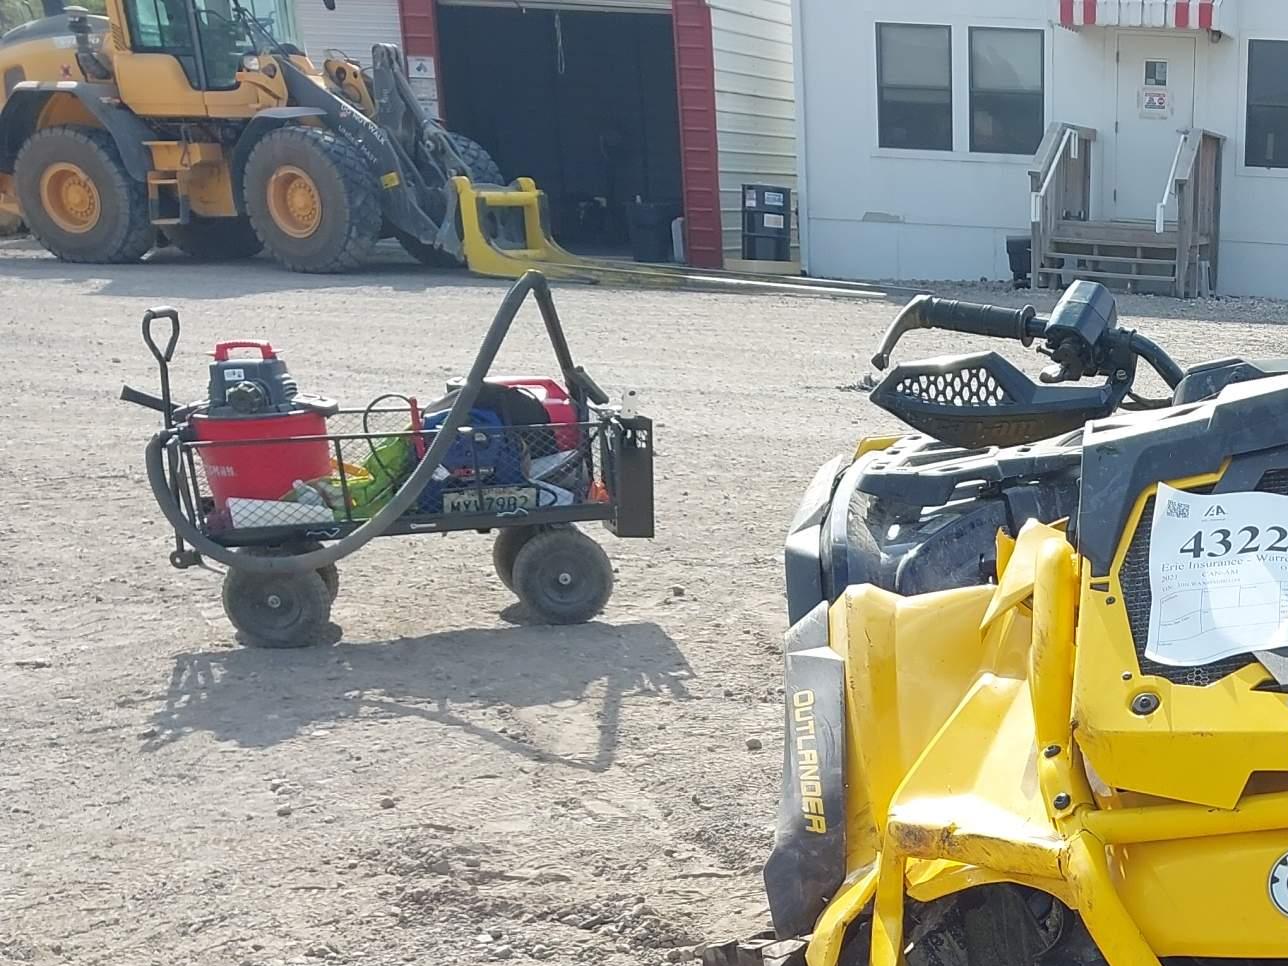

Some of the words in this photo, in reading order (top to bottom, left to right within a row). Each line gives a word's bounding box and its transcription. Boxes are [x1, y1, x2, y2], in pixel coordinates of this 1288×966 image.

[368, 123, 385, 145] WALK
[1188, 557, 1243, 570] Insurance
[793, 688, 827, 834] OUTLANDER
